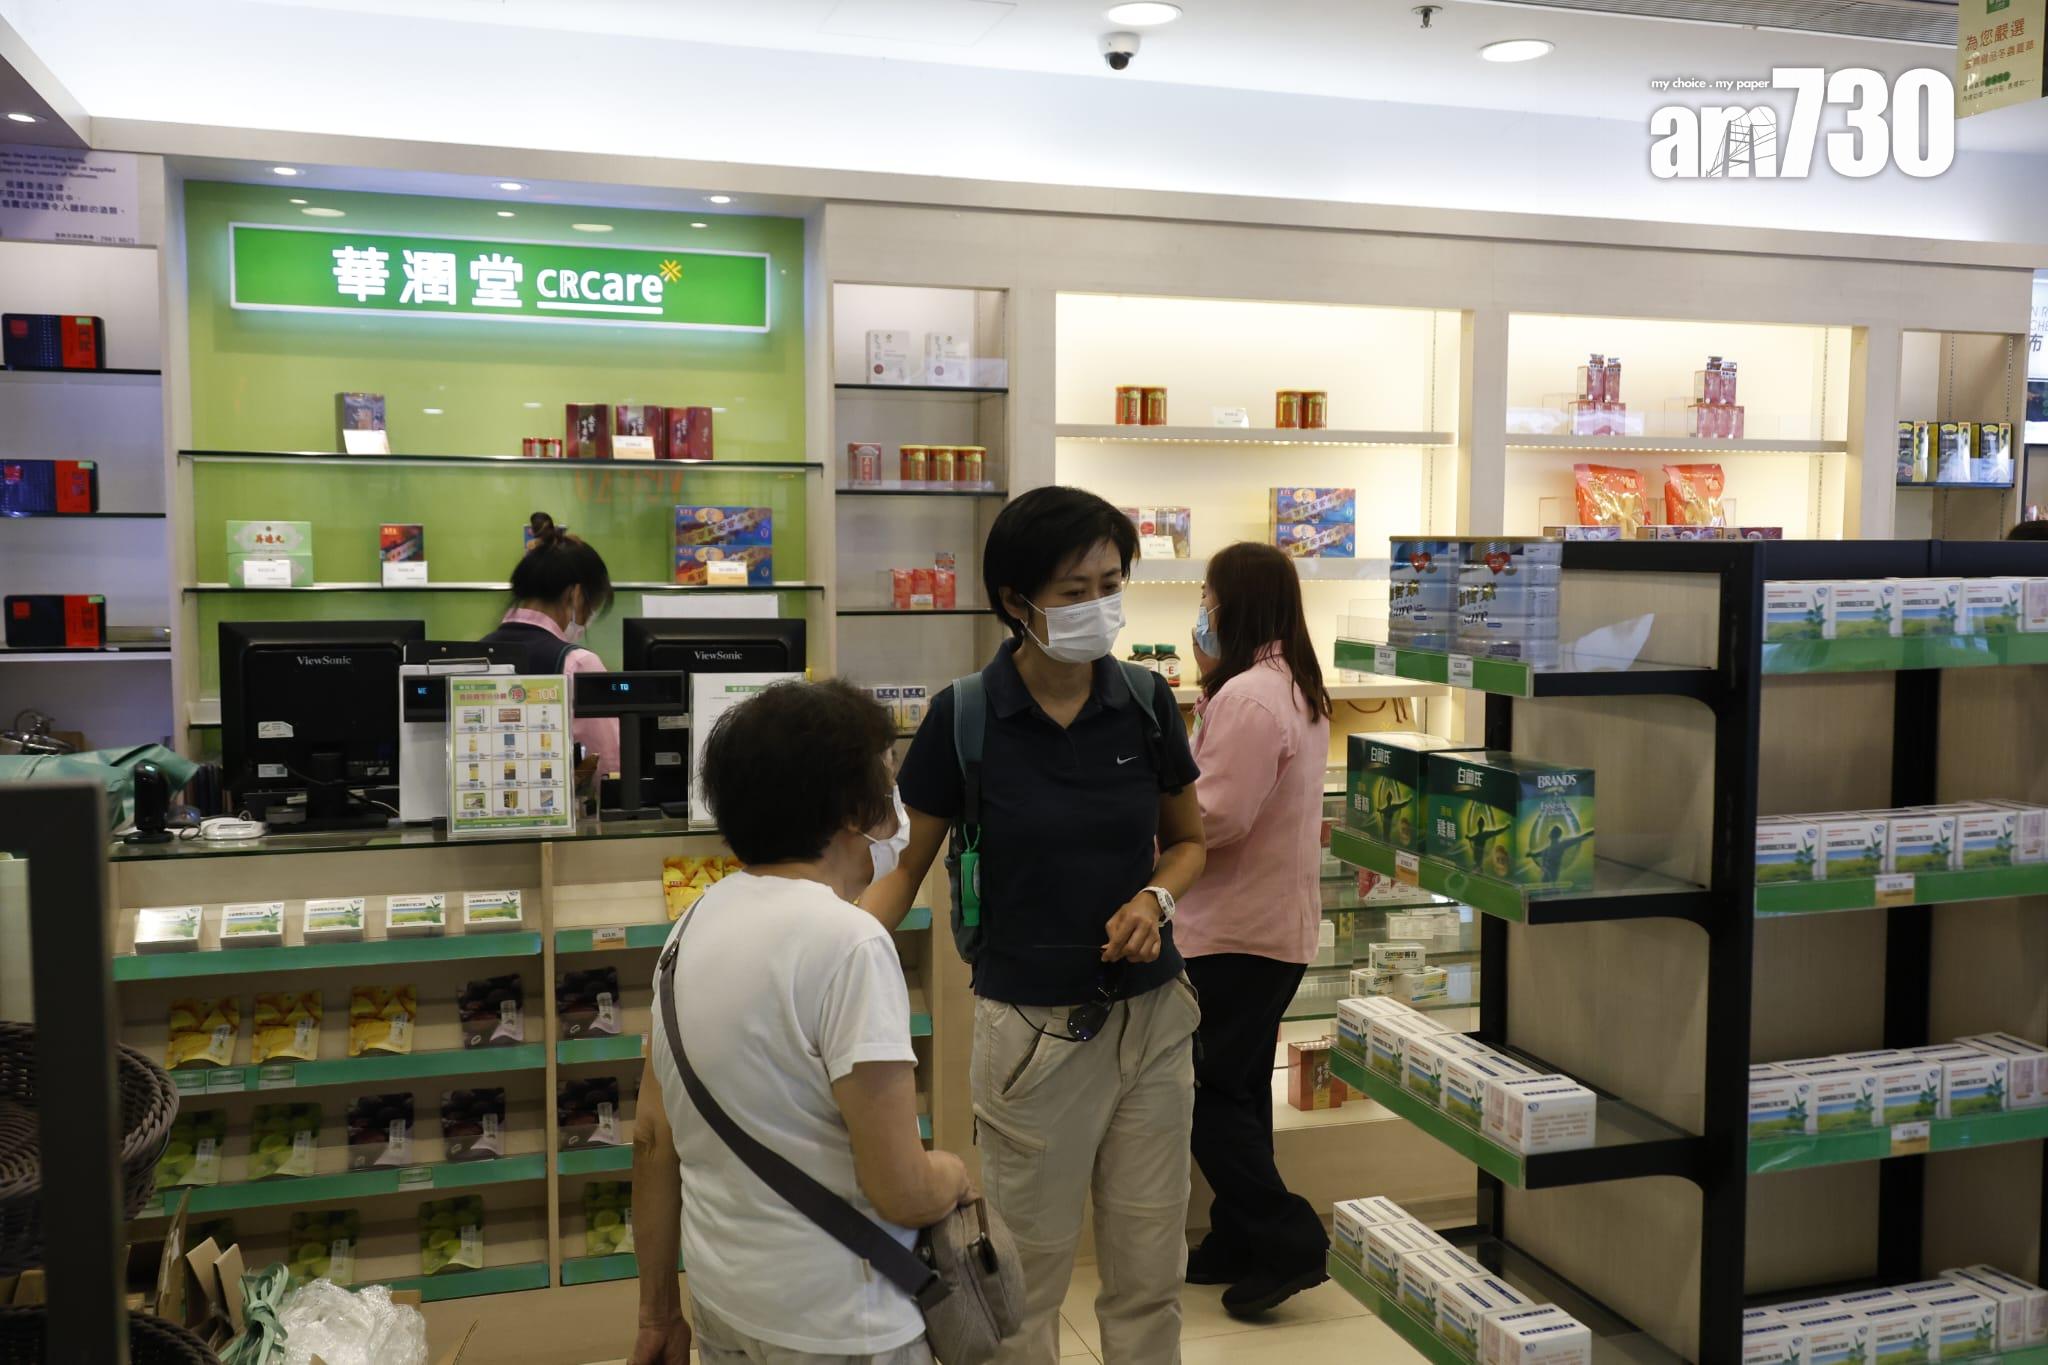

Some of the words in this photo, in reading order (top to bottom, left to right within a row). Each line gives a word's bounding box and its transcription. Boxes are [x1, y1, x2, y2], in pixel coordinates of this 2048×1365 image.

[1965, 17, 2025, 52] 為您嚴選
[332, 245, 523, 308] 華潤堂
[296, 655, 352, 666] ViewSonic
[694, 650, 743, 661] ViewSonic
[1370, 747, 1392, 764] 白蘭氏
[1458, 767, 1485, 788] 白蘭氏
